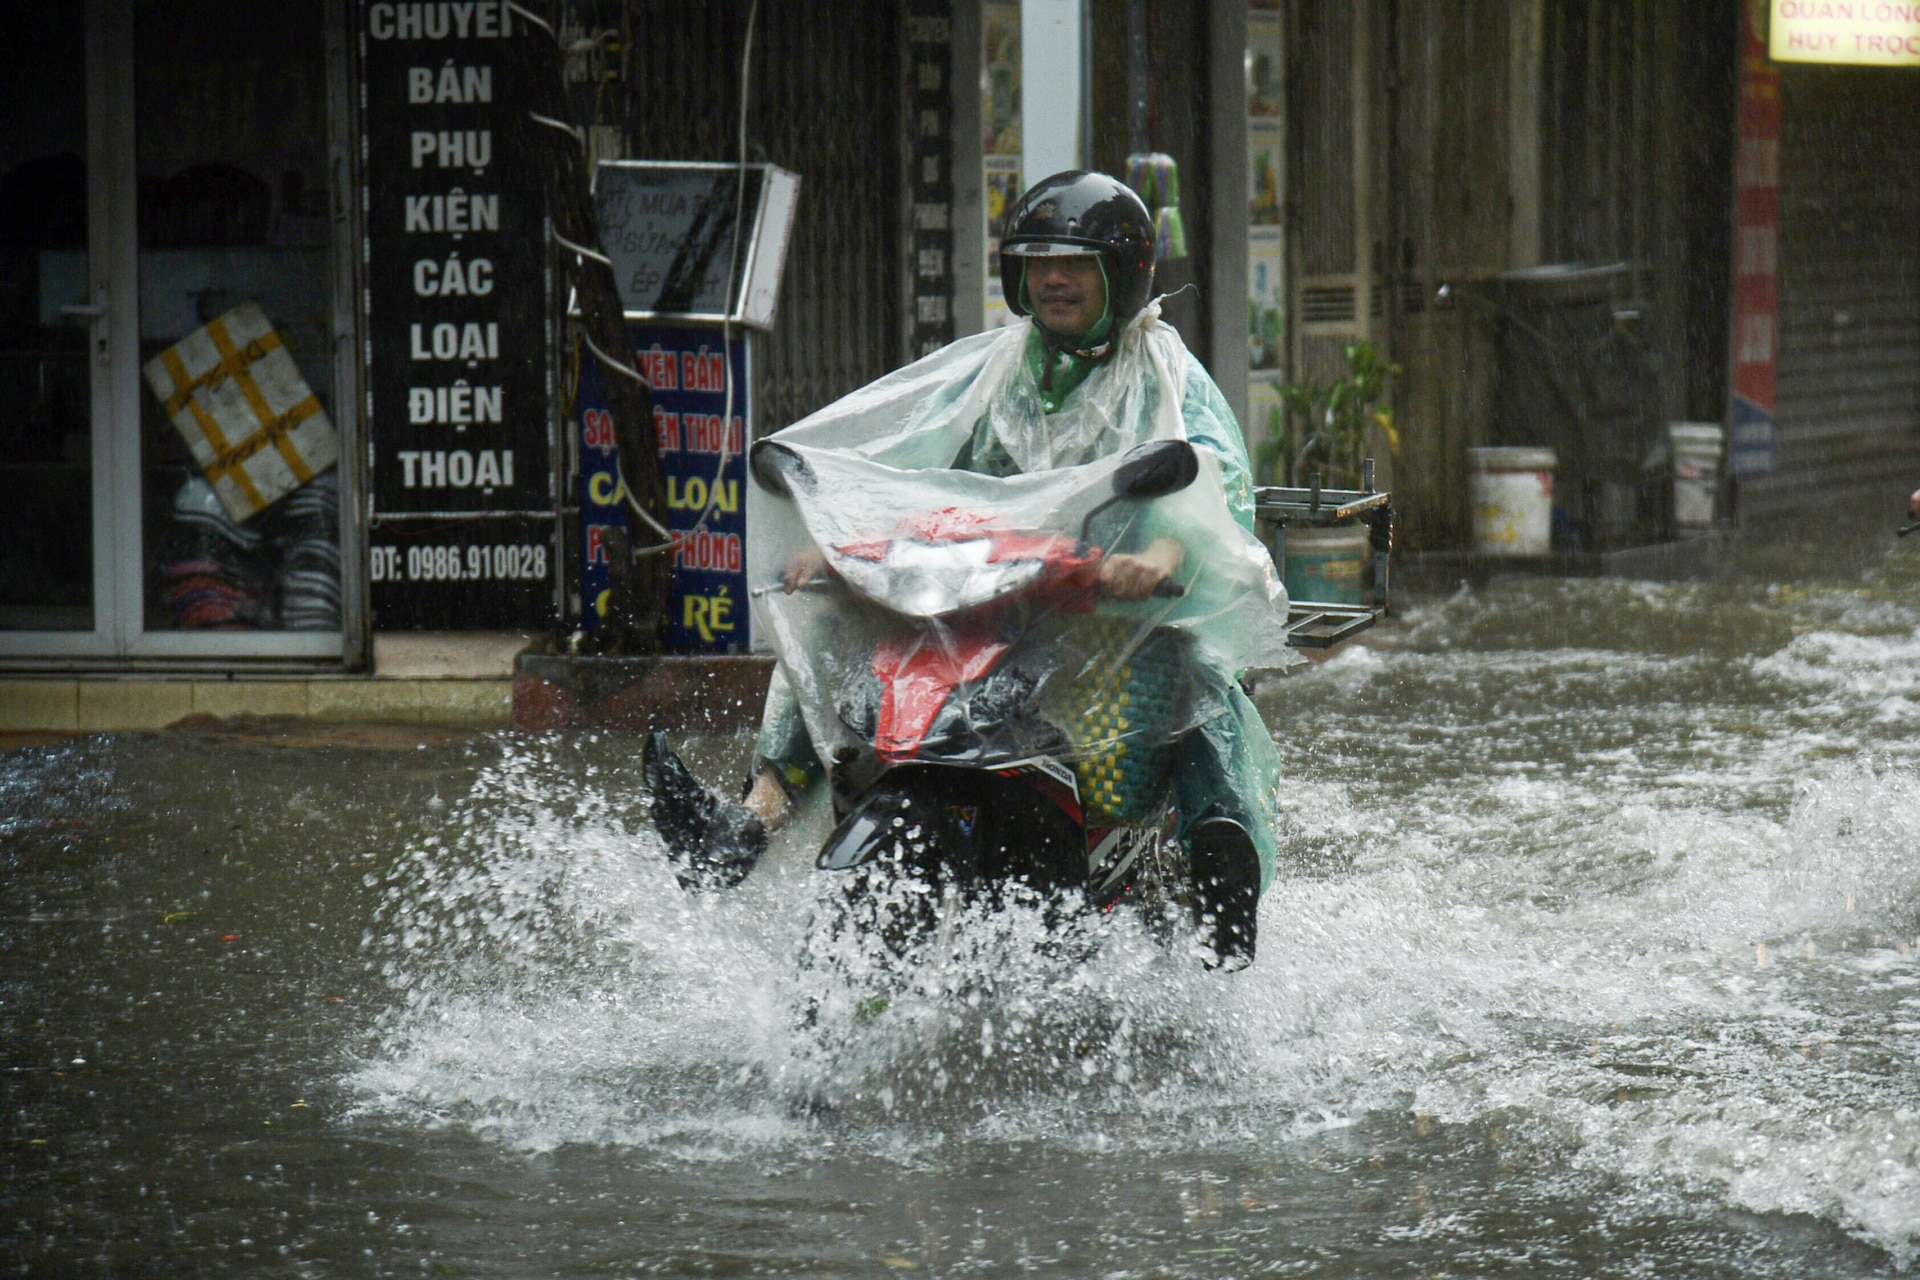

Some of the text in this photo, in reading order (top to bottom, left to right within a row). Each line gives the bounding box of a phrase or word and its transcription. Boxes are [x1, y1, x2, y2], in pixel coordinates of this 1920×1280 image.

[1788, 31, 1838, 52] HUY
[408, 59, 492, 103] BÁN
[411, 130, 491, 176] PHỤ
[405, 187, 498, 240] KIỆN
[413, 251, 493, 297] CÁC
[410, 322, 498, 367] LOẠI
[682, 345, 725, 392] BÁN
[408, 379, 502, 431] ĐIỆN
[398, 450, 514, 494] THOẠI
[408, 543, 547, 581] 0986.910028
[683, 585, 735, 642] RẺ
[1042, 758, 1073, 783] HONDA
